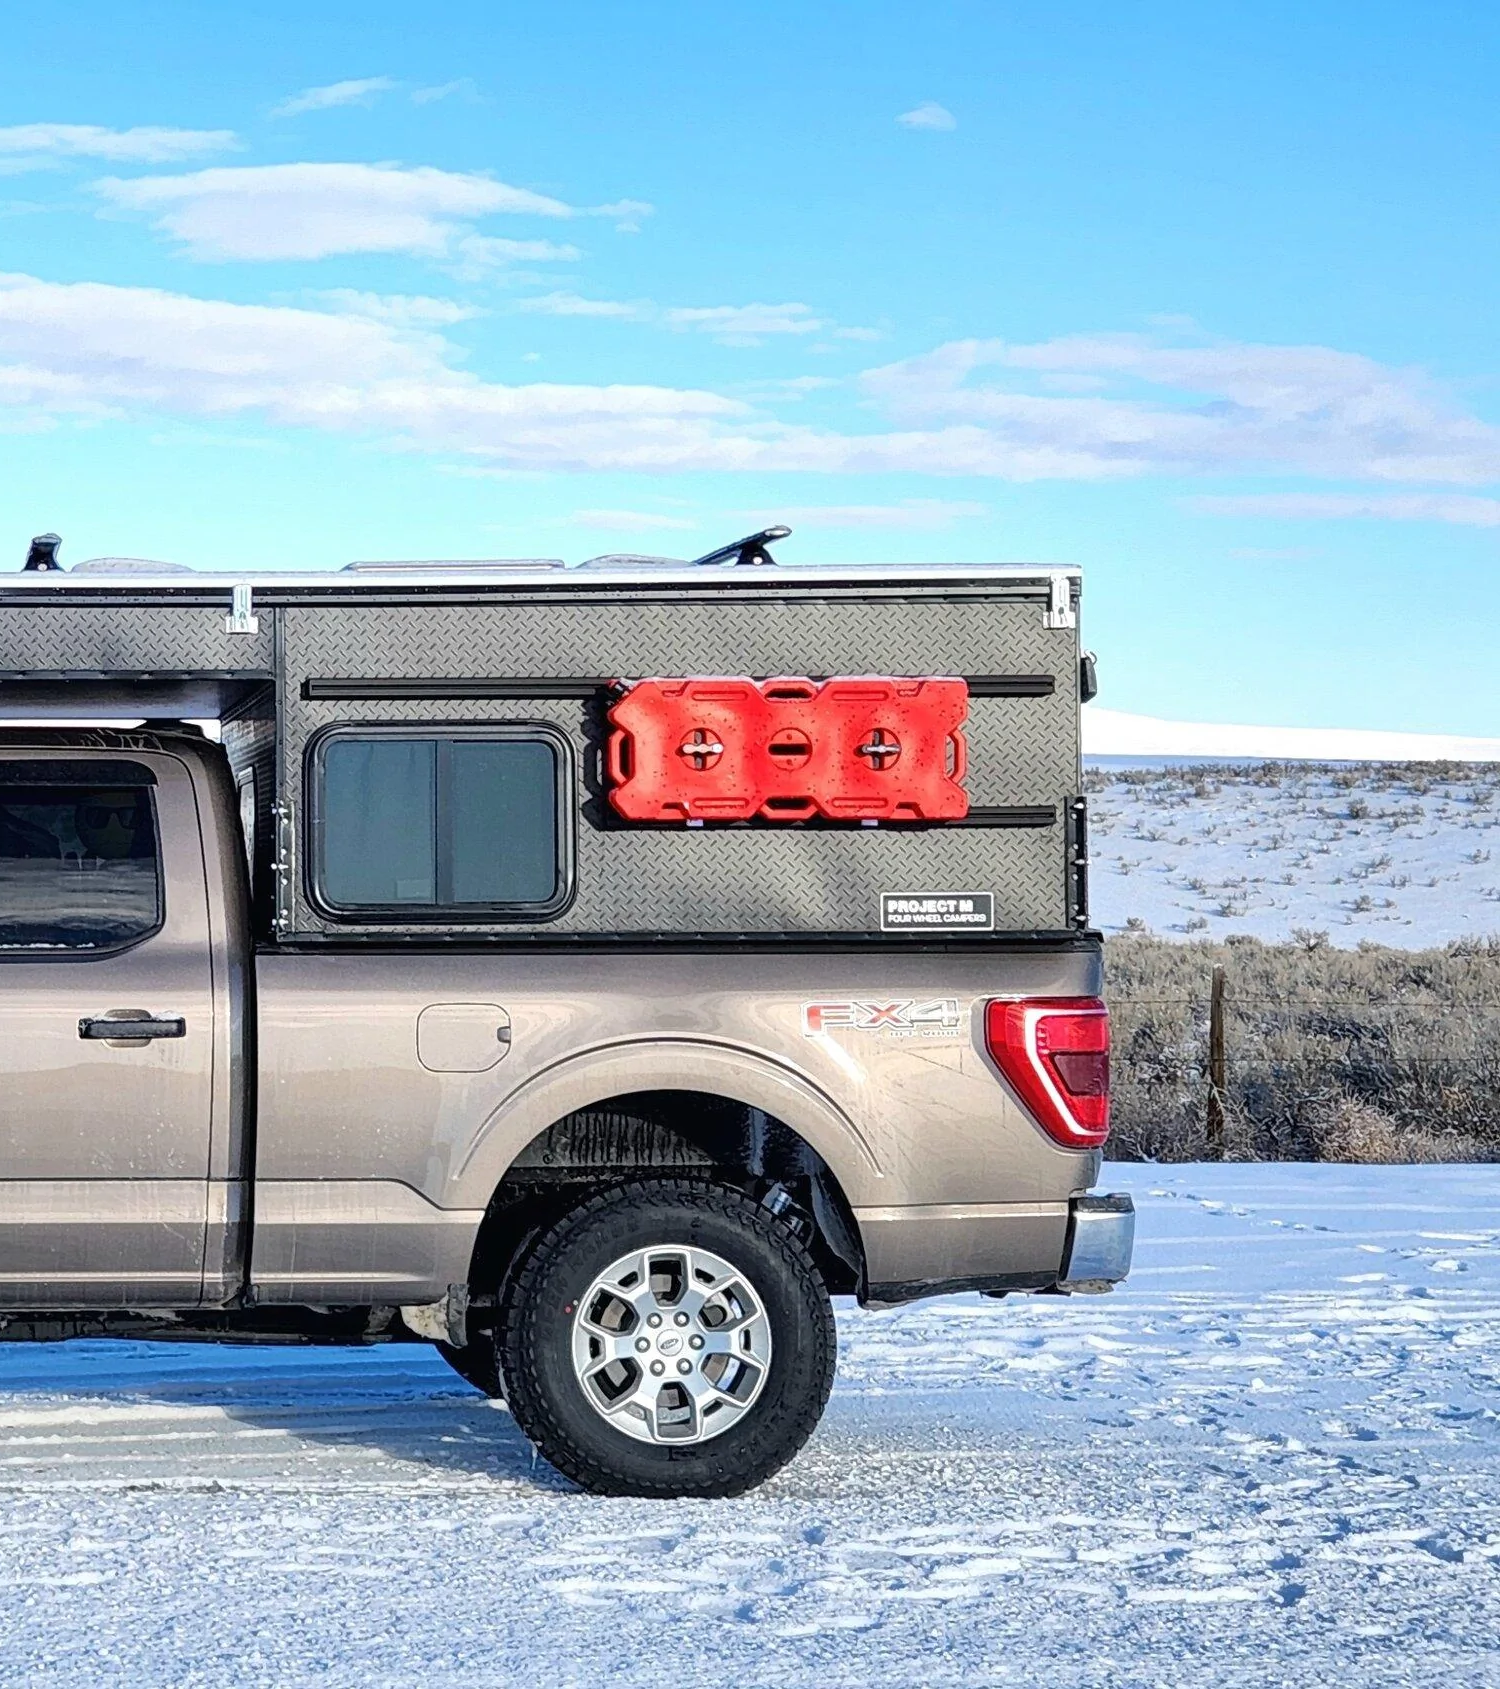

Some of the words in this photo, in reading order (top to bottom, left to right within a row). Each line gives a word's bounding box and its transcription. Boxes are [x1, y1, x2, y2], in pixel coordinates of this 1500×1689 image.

[887, 899, 957, 913] PROJECT
[959, 899, 974, 913] M
[887, 914, 912, 923] FOUR
[912, 914, 942, 923] WHEEL
[943, 914, 987, 923] CAMPERS
[801, 999, 960, 1032] FX4
